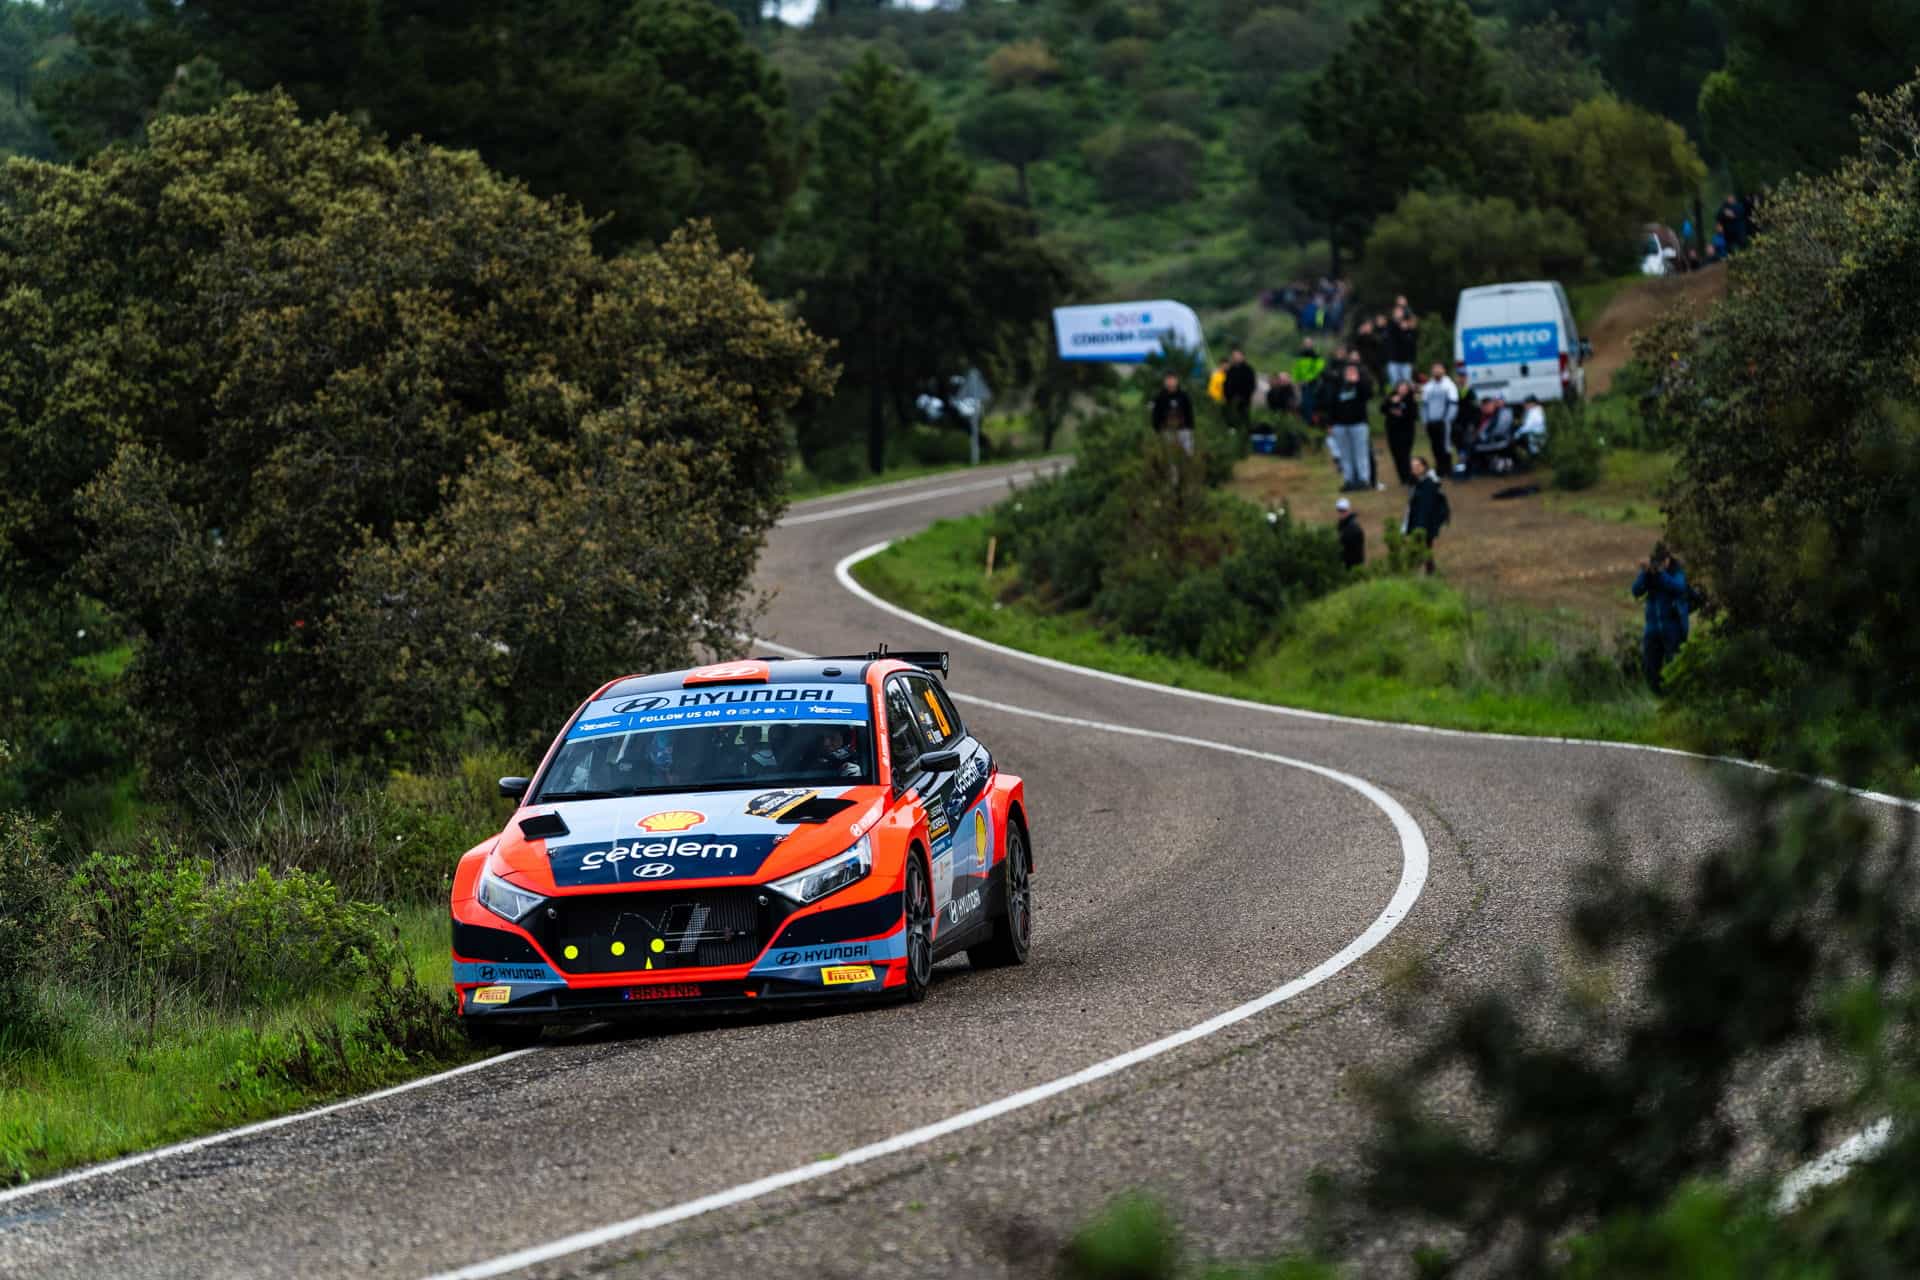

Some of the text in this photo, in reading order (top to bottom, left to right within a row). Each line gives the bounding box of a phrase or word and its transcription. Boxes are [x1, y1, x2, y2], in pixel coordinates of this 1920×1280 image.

[679, 689, 834, 706] HYUNDAI
[639, 713, 685, 723] FOLLOW
[686, 711, 702, 719] US
[580, 837, 738, 871] cetelem
[804, 944, 869, 963] HYUNDAI
[498, 967, 547, 980] HYUNDAI
[826, 968, 869, 981] PIRELLI
